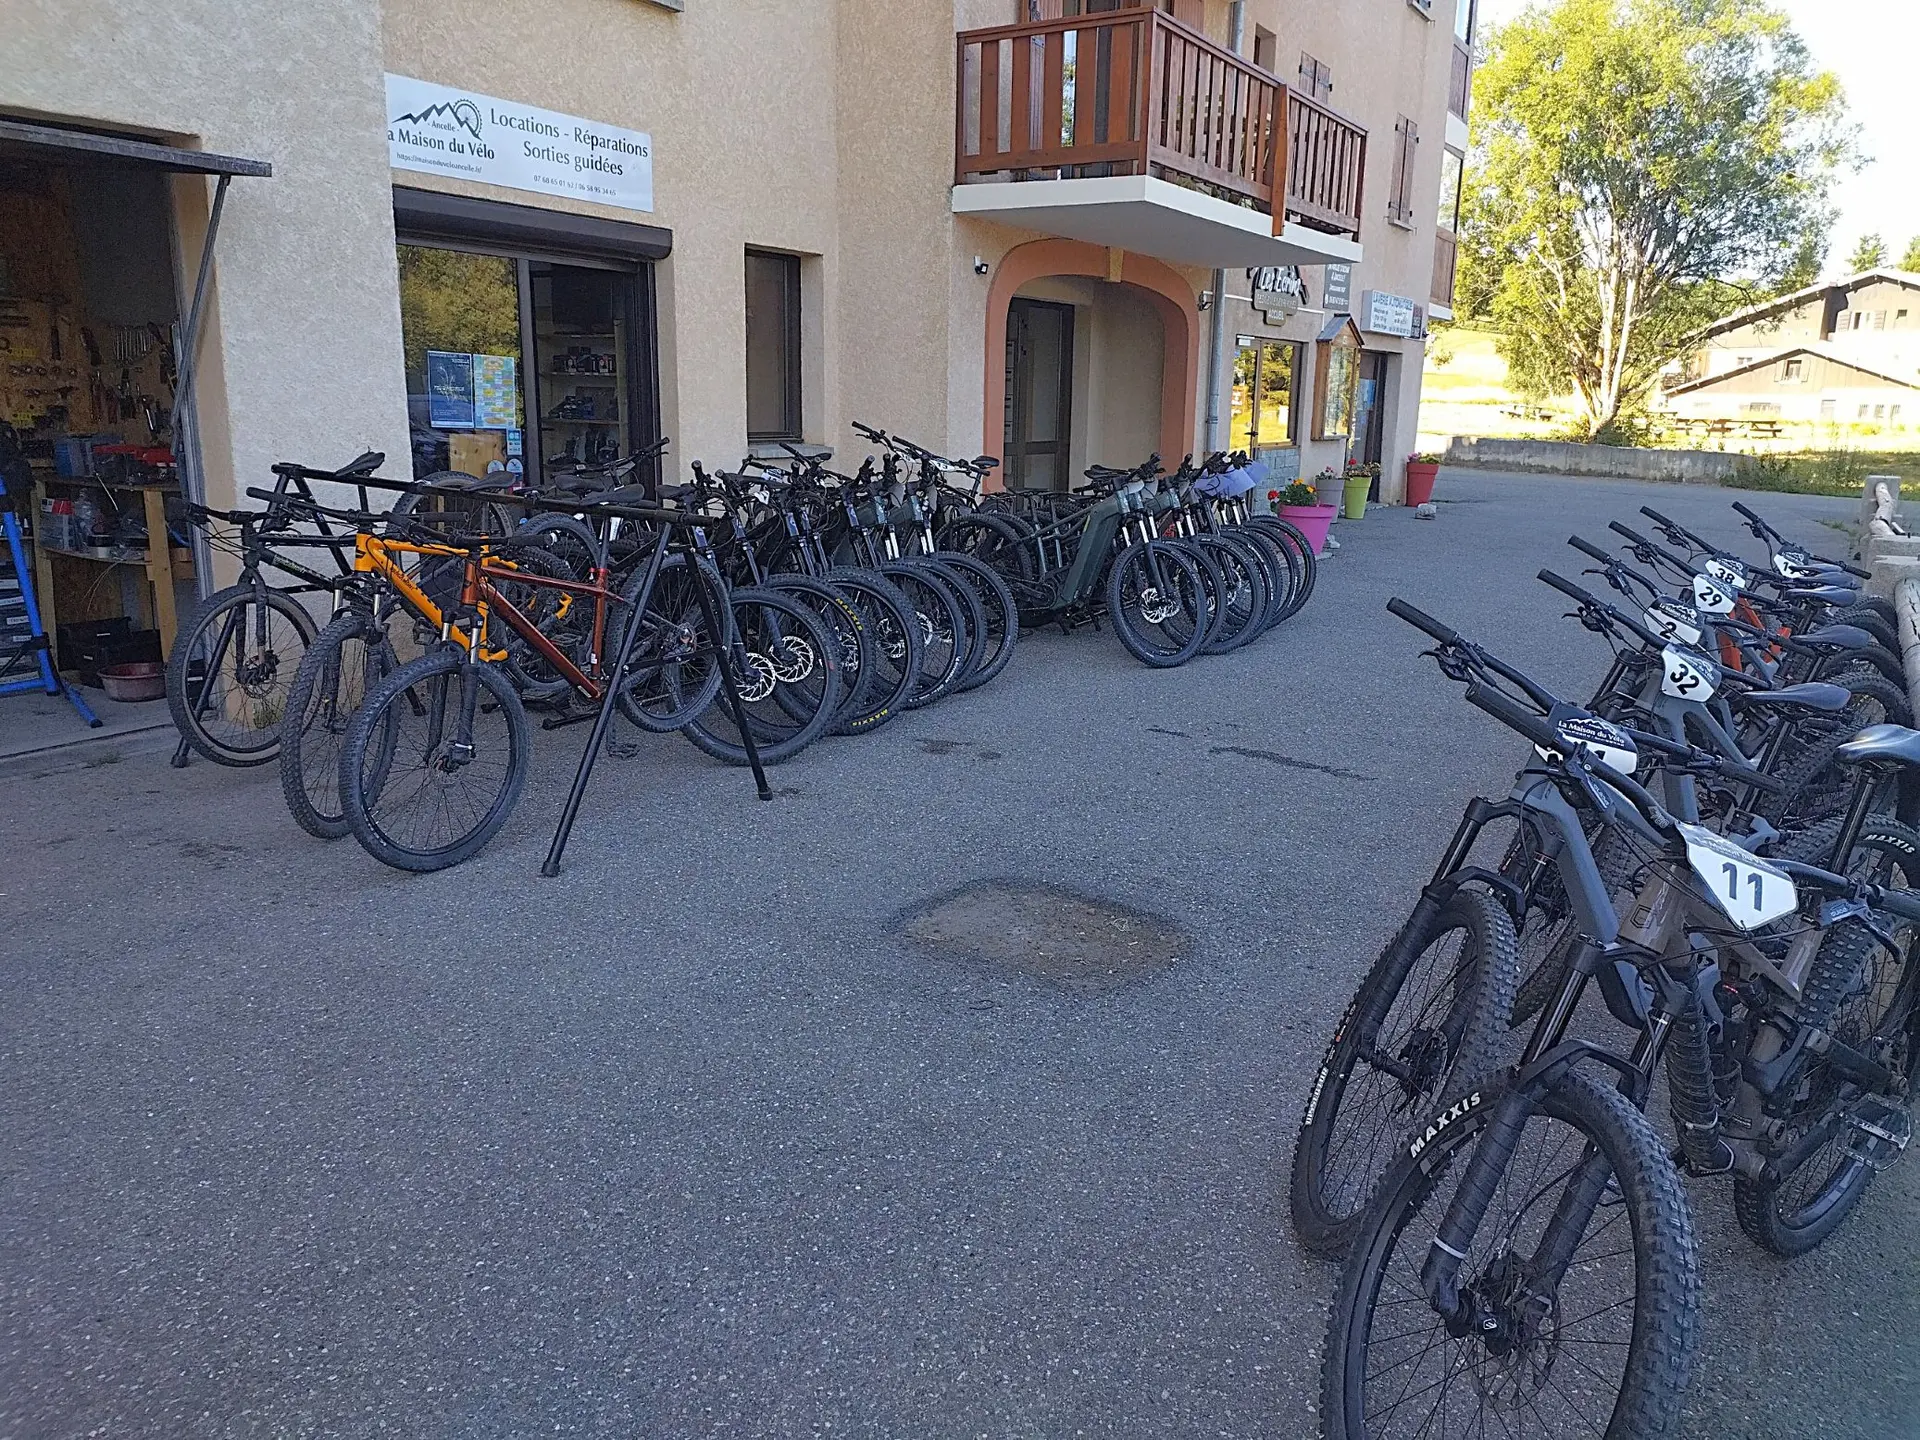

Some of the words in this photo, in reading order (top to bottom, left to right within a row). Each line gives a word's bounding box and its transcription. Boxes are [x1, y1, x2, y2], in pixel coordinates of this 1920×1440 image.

[431, 120, 456, 132] Ancelle
[491, 108, 560, 138] Locations
[574, 127, 648, 158] Réparations
[387, 129, 395, 141] a
[398, 128, 445, 151] Maison
[449, 138, 465, 154] du
[468, 141, 495, 160] Vélo
[523, 140, 570, 165] Sorties
[574, 154, 623, 176] guidées
[1715, 567, 1736, 585] 38
[1698, 586, 1723, 607] 29
[835, 598, 864, 631] MAXXIS
[1669, 663, 1700, 696] 32
[1558, 720, 1567, 728] La
[1568, 723, 1596, 736] Maison
[1596, 730, 1607, 738] du
[1864, 833, 1916, 855] MAXXIS
[1722, 861, 1763, 912] 11
[1410, 1092, 1481, 1158] MAXXIS
